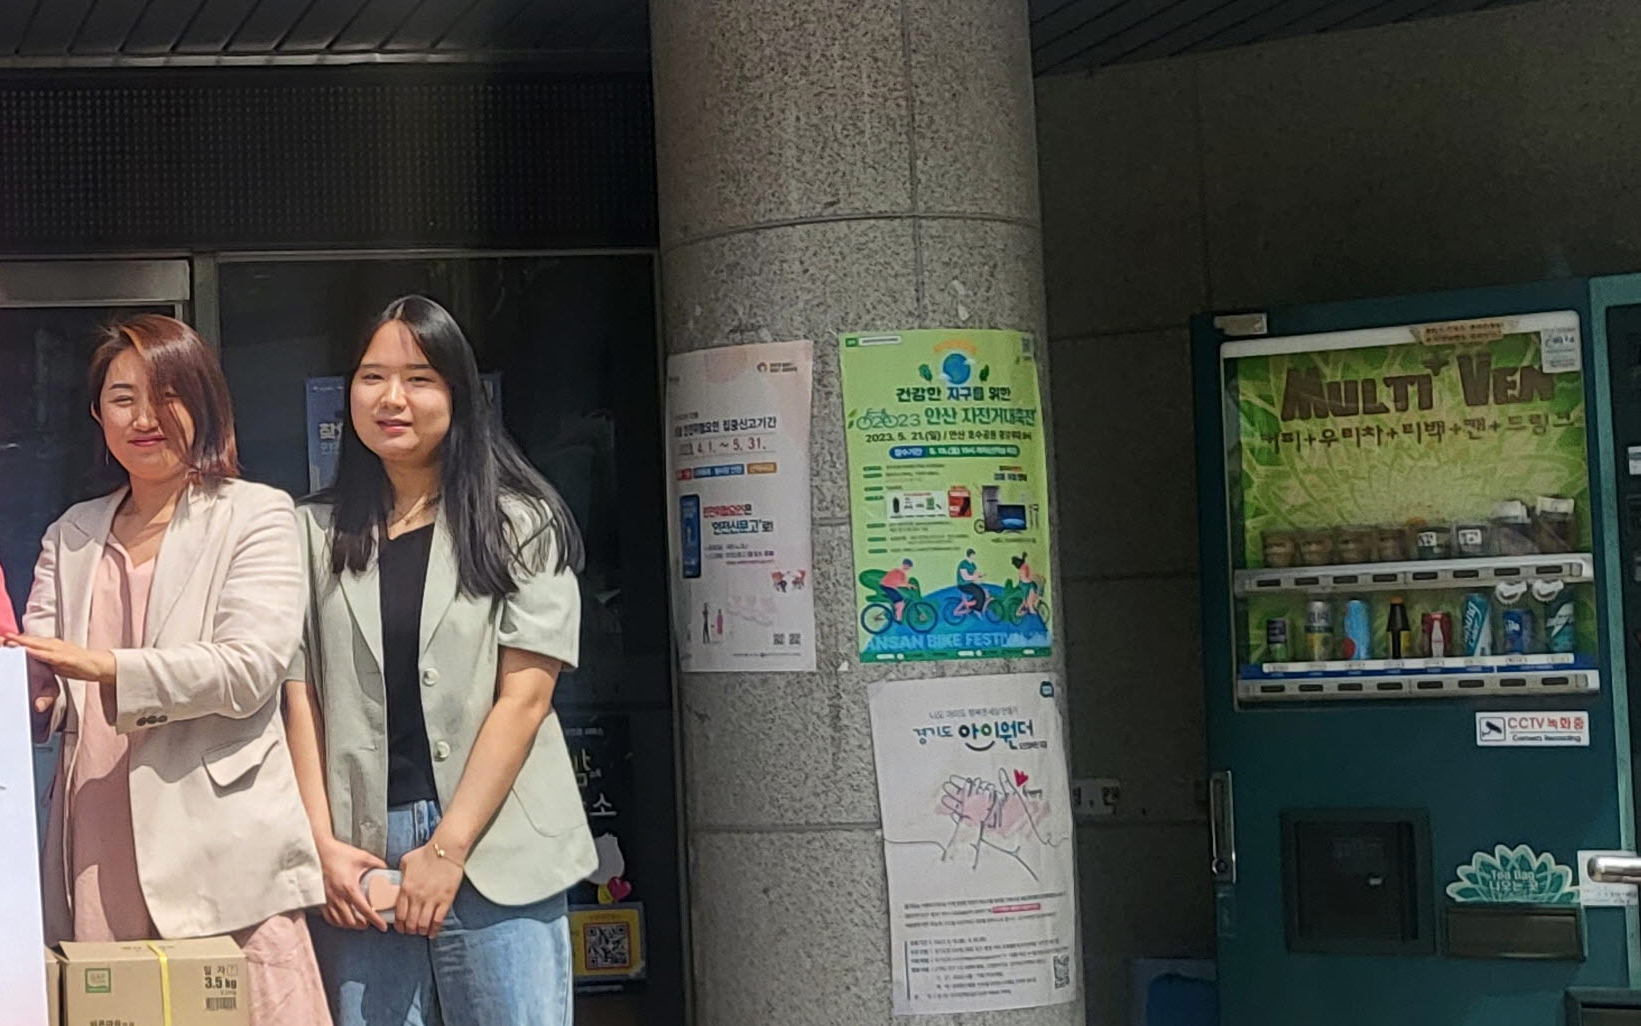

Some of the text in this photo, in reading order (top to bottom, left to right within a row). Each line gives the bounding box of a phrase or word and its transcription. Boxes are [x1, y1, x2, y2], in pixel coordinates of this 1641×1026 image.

[896, 387, 941, 402] 건강한
[989, 386, 1011, 401] 위한
[1281, 366, 1433, 422] MULTI
[924, 407, 958, 425] 안산
[866, 635, 925, 651] ANSAN
[926, 633, 961, 648] BIKE
[1508, 717, 1545, 729] CCTV
[205, 977, 237, 989] 3.5 kg
